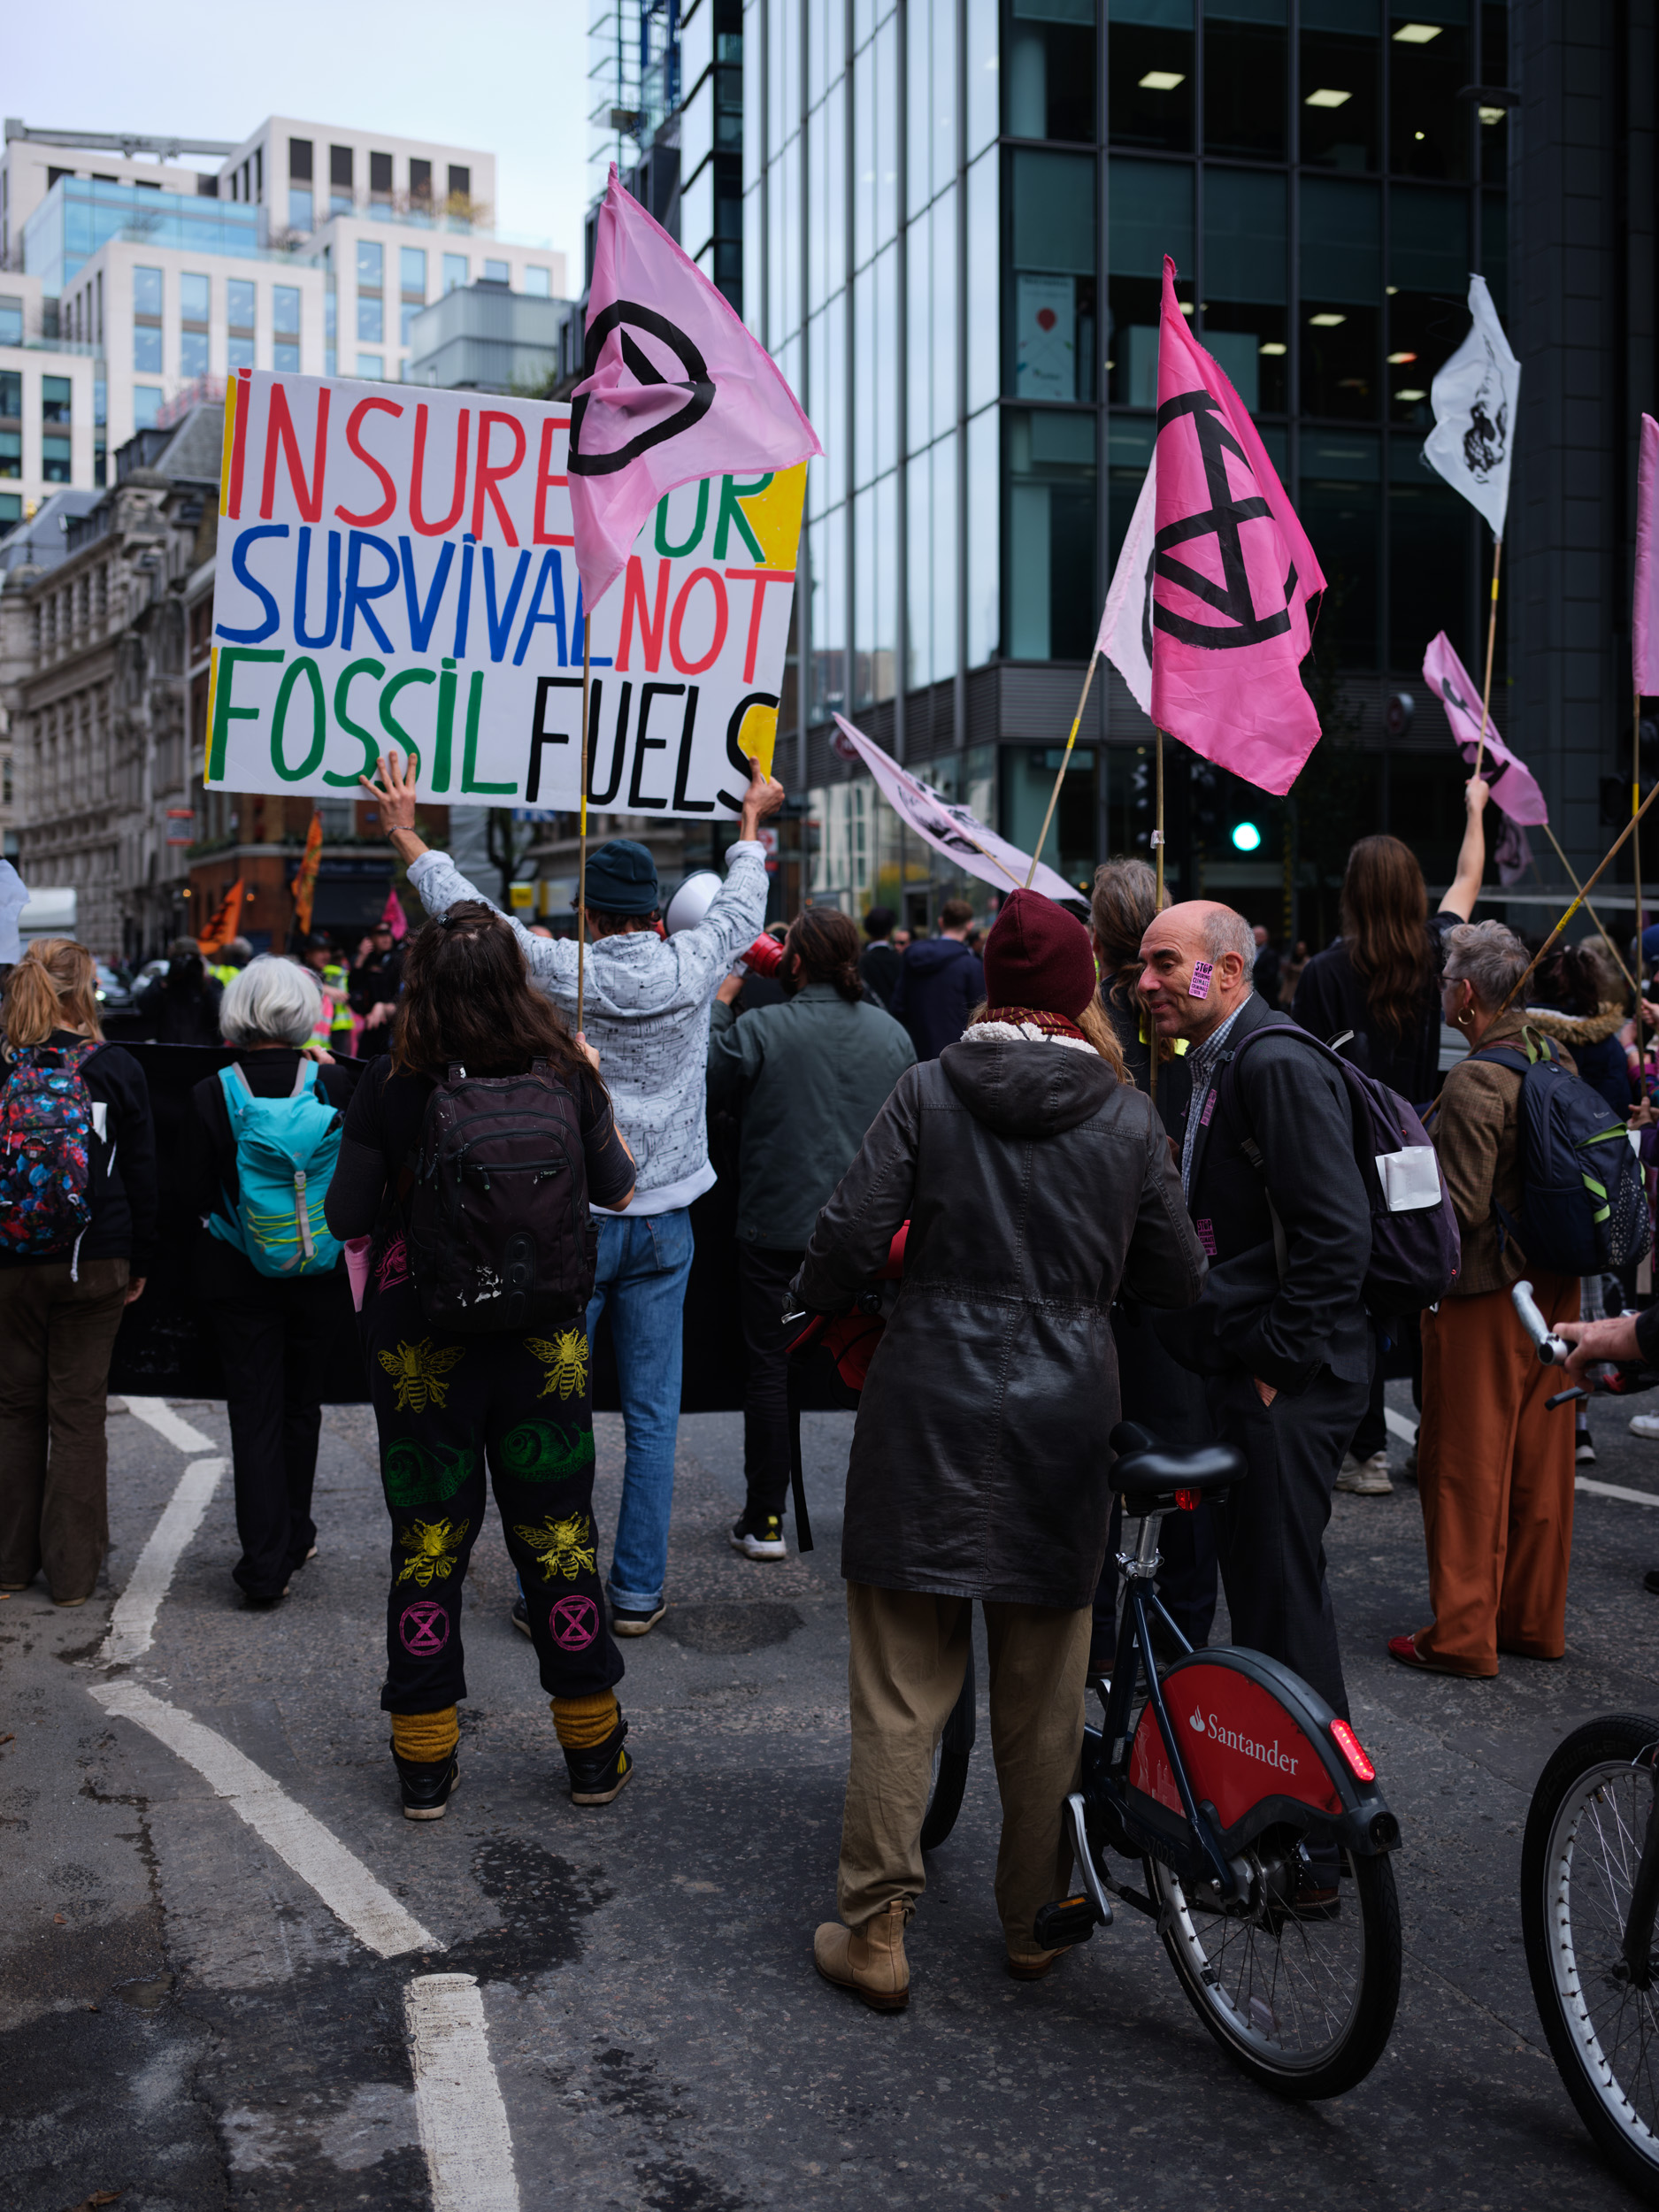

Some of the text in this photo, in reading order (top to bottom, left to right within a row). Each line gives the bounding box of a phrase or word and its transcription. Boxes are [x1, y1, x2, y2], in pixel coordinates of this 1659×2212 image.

[228, 368, 772, 563] INSURE UR
[216, 525, 795, 684] SURVIVAL NOT
[209, 646, 780, 812] FOSSIL FUELS
[1195, 962, 1213, 974] STOP
[1193, 977, 1210, 987] CLIMATE
[1194, 972, 1210, 980] INSURING
[1191, 983, 1208, 992] CRIMINALS
[1198, 1220, 1211, 1230] STOP
[1208, 1714, 1299, 1776] Santander
